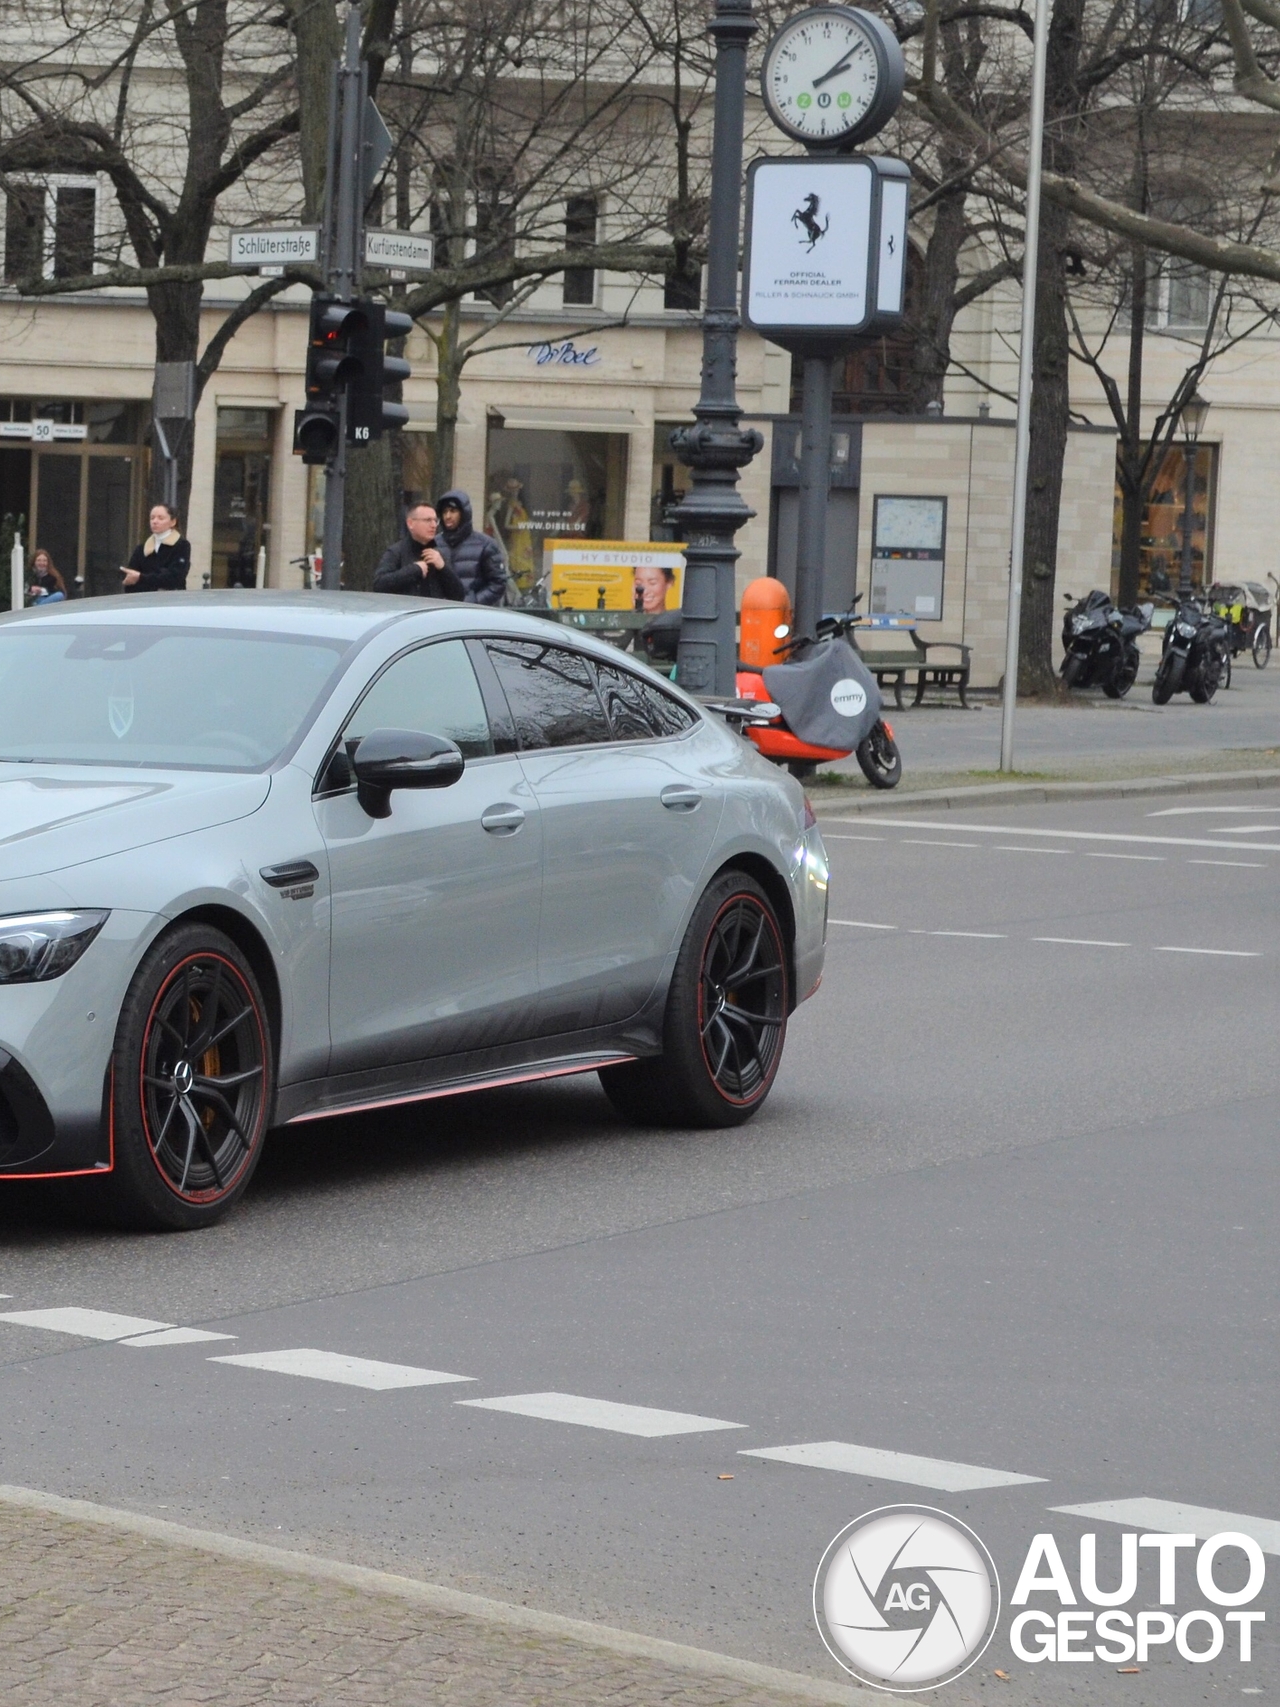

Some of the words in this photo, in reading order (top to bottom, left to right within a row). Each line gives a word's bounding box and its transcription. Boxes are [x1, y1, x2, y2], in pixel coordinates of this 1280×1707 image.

[823, 30, 832, 39] 12
[804, 37, 812, 45] 11
[789, 53, 798, 61] 10
[783, 75, 788, 84] 9
[863, 73, 868, 82] 3
[787, 97, 793, 105] 8
[238, 236, 311, 256] Schlüterstraße
[367, 236, 430, 260] Kurfürstendamm
[36, 426, 50, 436] 50
[355, 426, 370, 440] K6
[547, 510, 561, 518] you
[518, 521, 586, 531] WWW.DIBEL.DE
[604, 554, 653, 564] STUDIO
[834, 693, 864, 704] emmy
